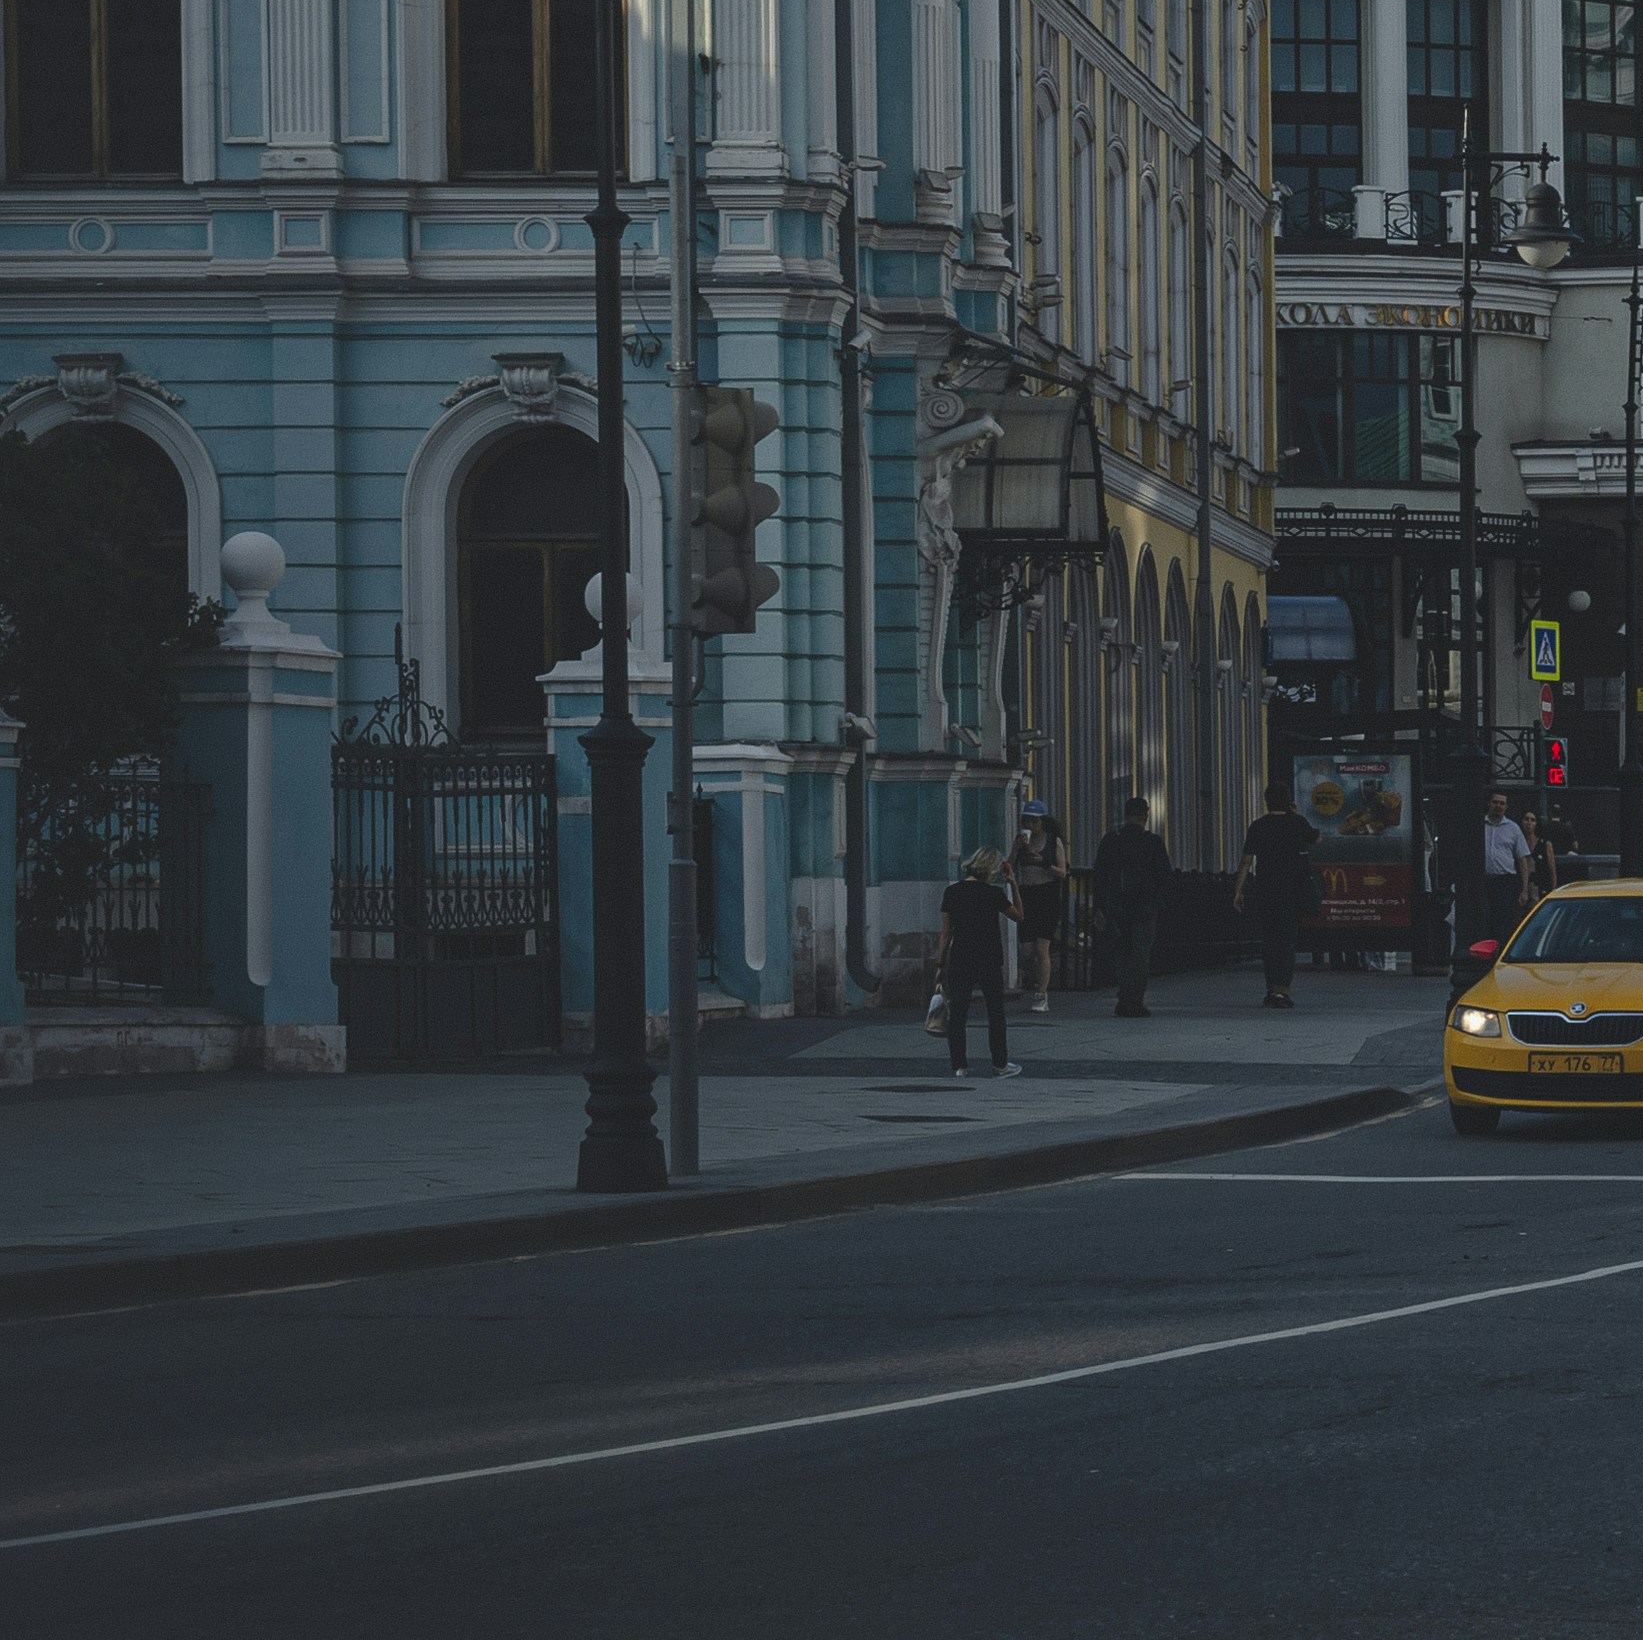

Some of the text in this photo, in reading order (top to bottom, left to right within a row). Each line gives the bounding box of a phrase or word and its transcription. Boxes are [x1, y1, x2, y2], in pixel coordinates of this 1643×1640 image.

[1275, 302, 1355, 326] КОЛА
[1537, 1055, 1616, 1072] ХУ 176 77
